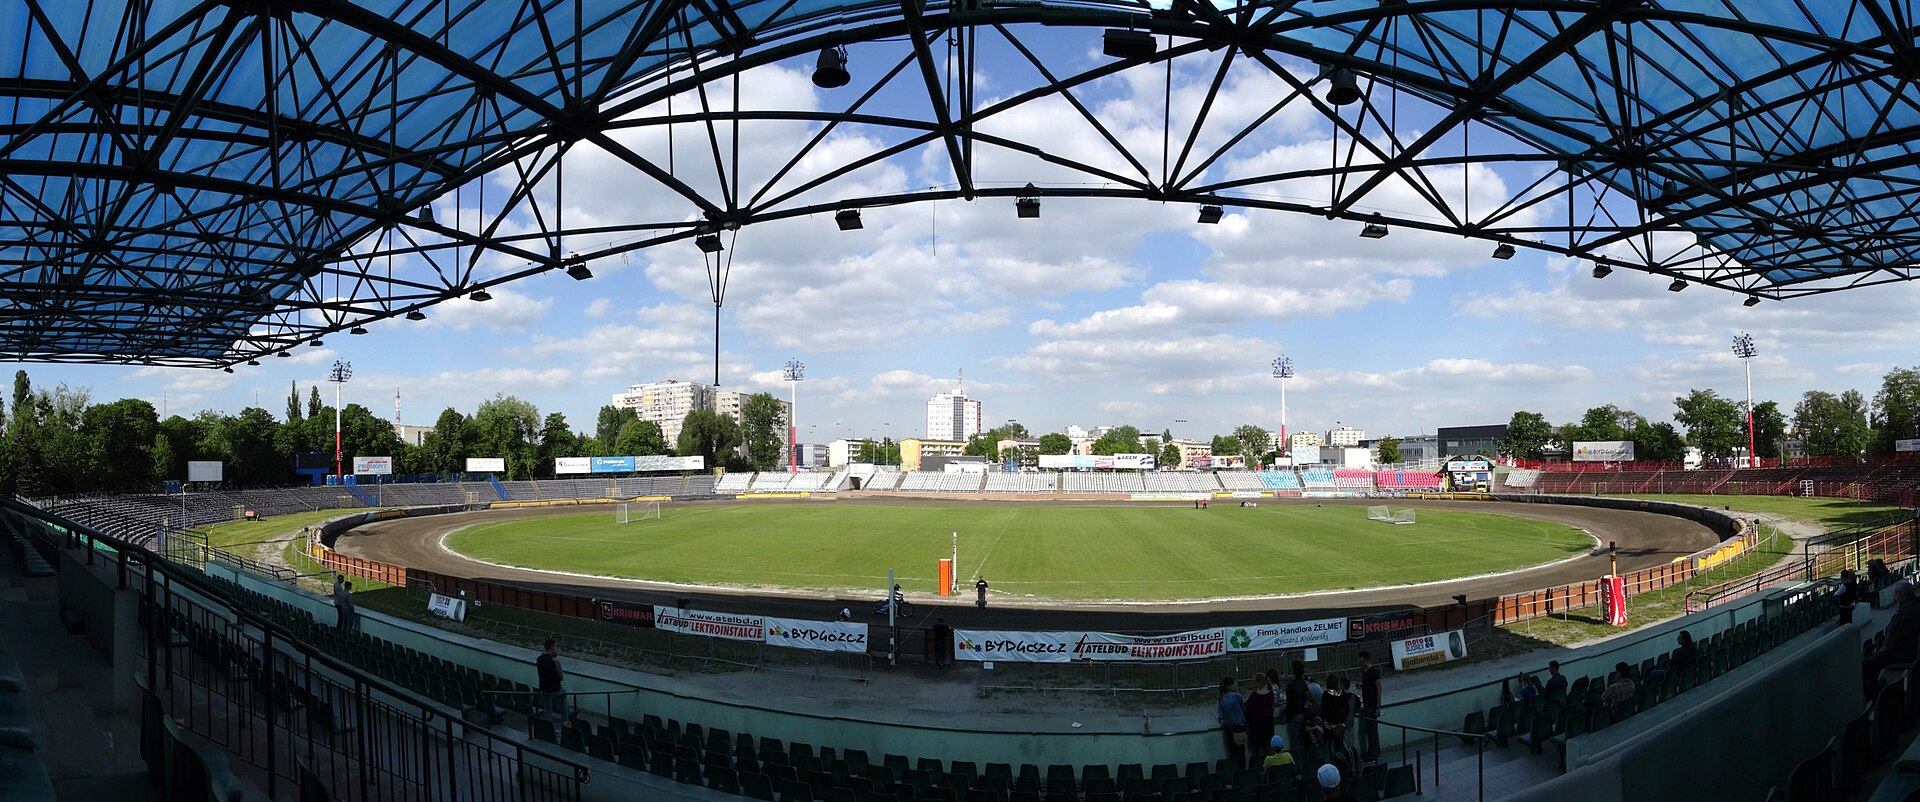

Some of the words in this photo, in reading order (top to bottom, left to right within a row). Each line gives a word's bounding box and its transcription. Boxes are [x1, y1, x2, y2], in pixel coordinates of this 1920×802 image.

[1365, 618, 1414, 634] KRISMAR
[1257, 628, 1279, 637] Firma
[1084, 645, 1129, 654] ATELBUD
[1402, 652, 1440, 668] Continental
